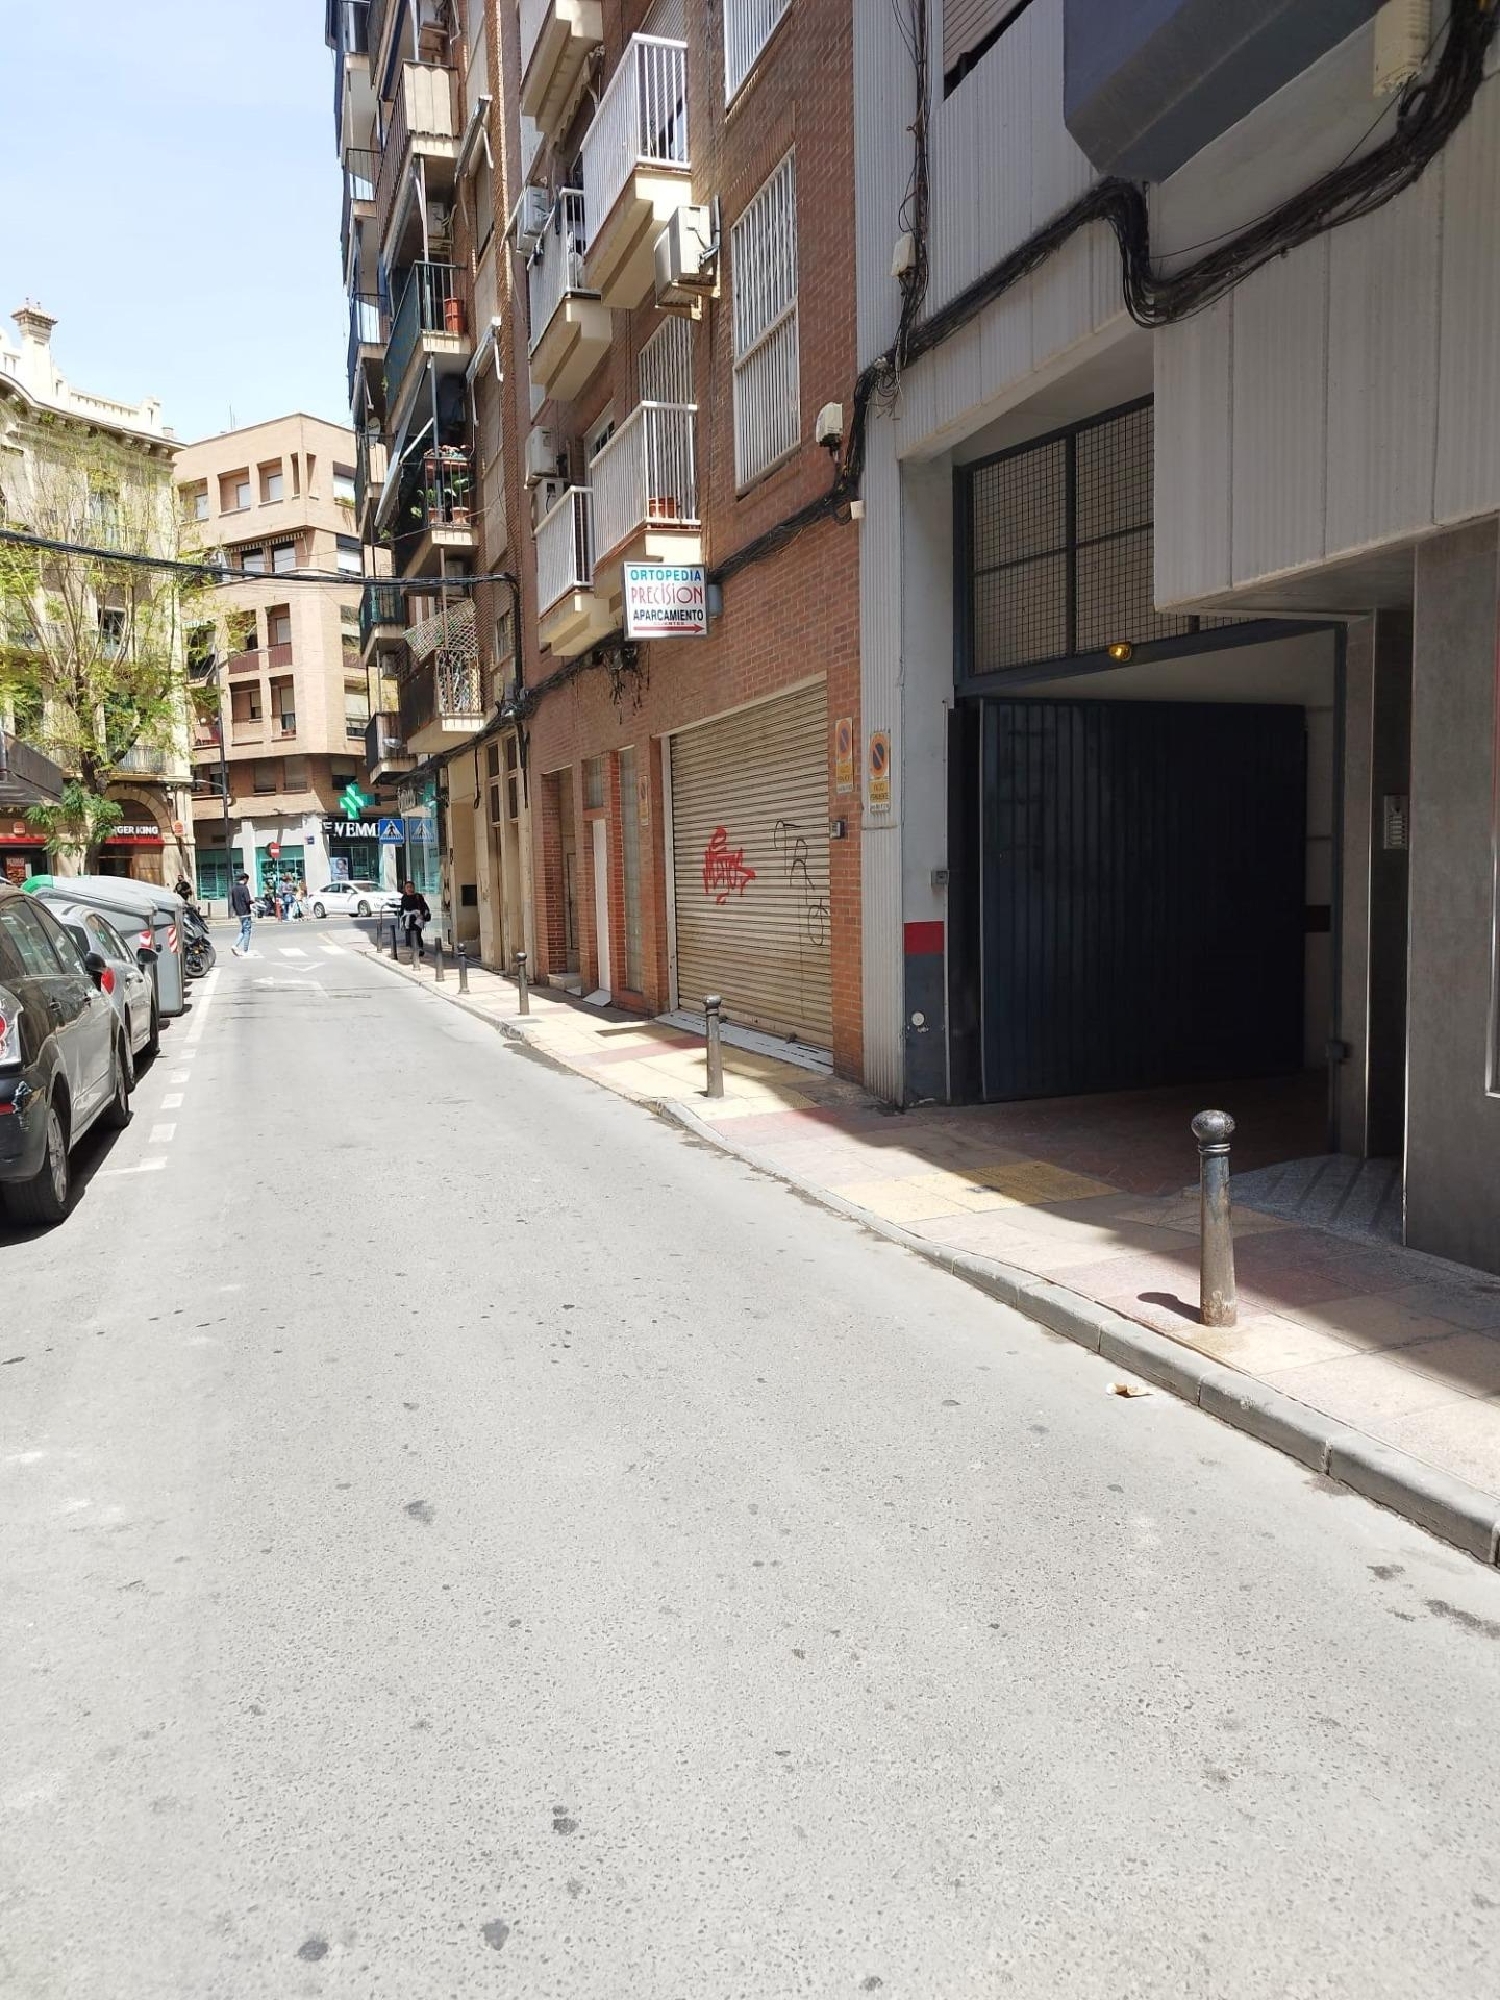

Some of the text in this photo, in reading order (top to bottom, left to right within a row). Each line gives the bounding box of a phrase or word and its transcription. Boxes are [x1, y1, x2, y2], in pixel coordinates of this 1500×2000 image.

[630, 569, 702, 582] ORTOPEDIA
[633, 609, 704, 621] APARCAMIENTO
[135, 825, 159, 835] KING
